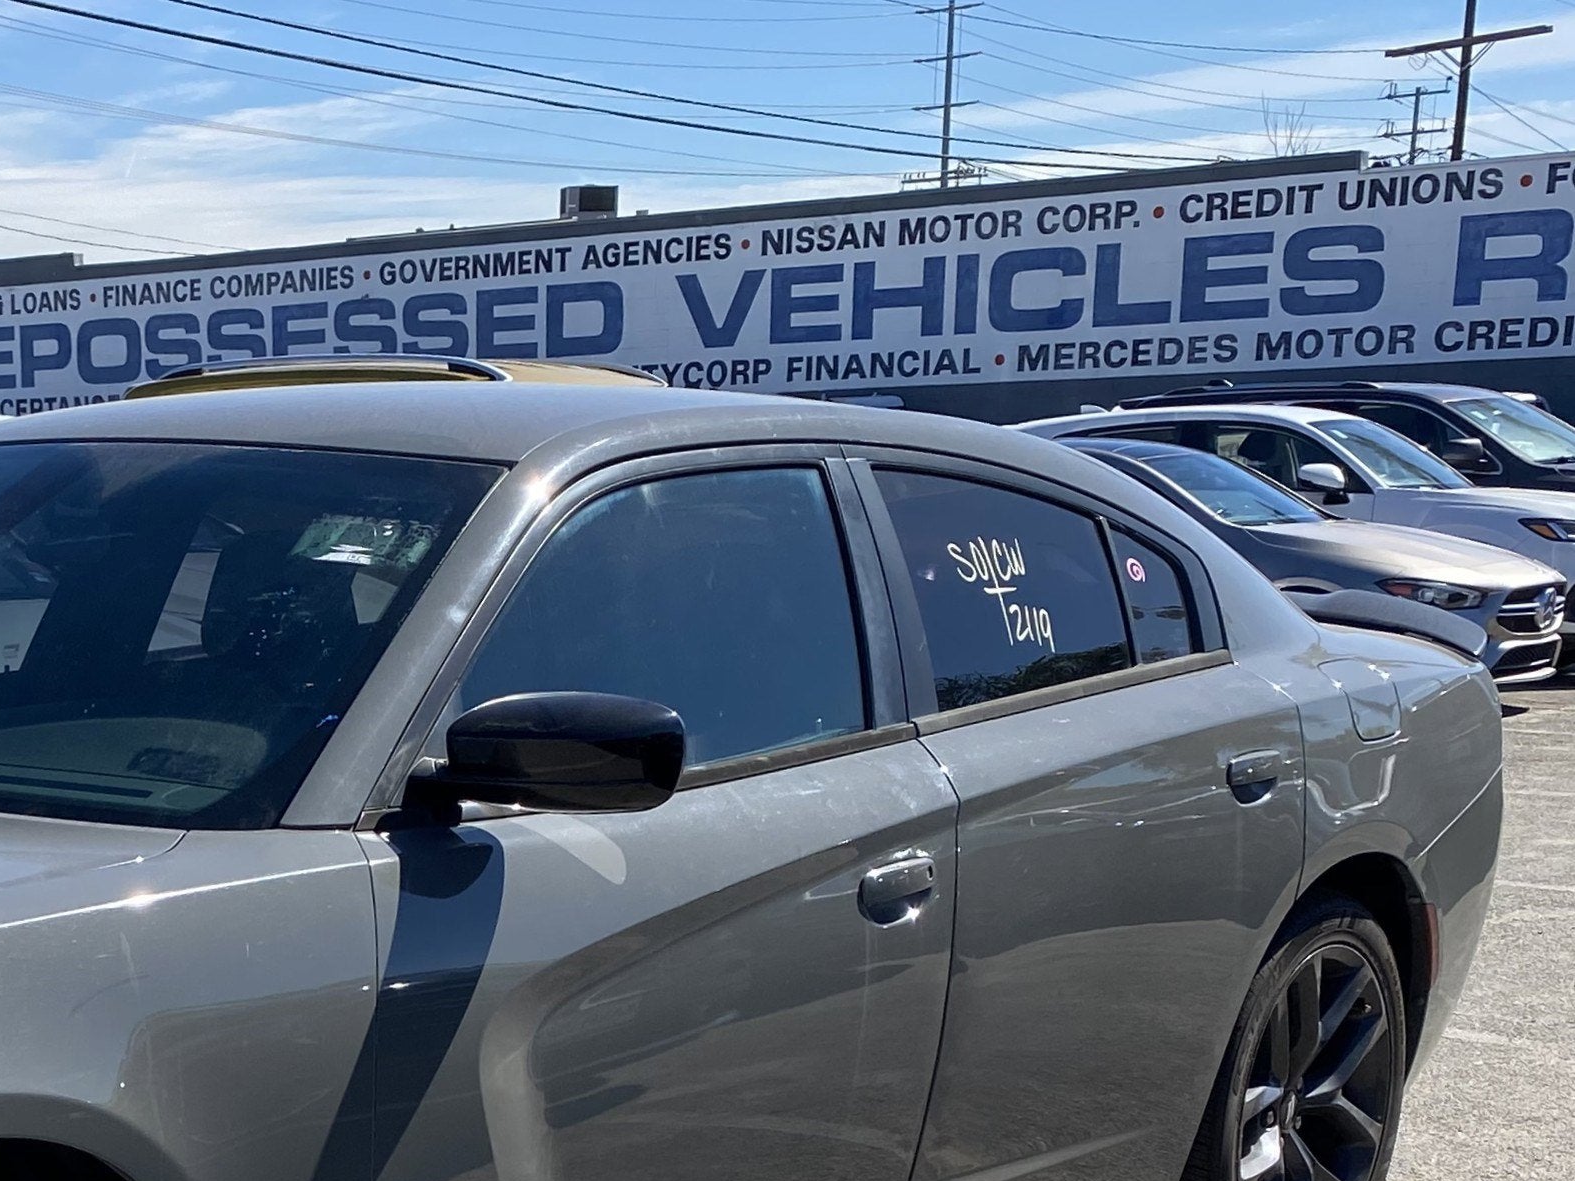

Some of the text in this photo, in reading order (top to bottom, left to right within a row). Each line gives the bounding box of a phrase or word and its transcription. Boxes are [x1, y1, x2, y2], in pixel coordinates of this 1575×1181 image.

[11, 289, 81, 314] LOANS
[103, 278, 202, 307] FINANCE
[210, 265, 354, 299] COMPANIES
[379, 246, 572, 285] GOVERNMENT
[582, 233, 732, 269] AGENCIES
[761, 219, 886, 256] NISSAN
[898, 209, 1022, 245] MOTOR
[1037, 200, 1141, 234] CORP.
[1179, 183, 1324, 223] CREDIT
[1338, 168, 1504, 210] UNIONS
[675, 224, 1385, 349] VEHICLES
[786, 347, 981, 382] FINANCIAL
[1017, 332, 1238, 373] MERCEDES
[1255, 324, 1416, 361] MOTOR
